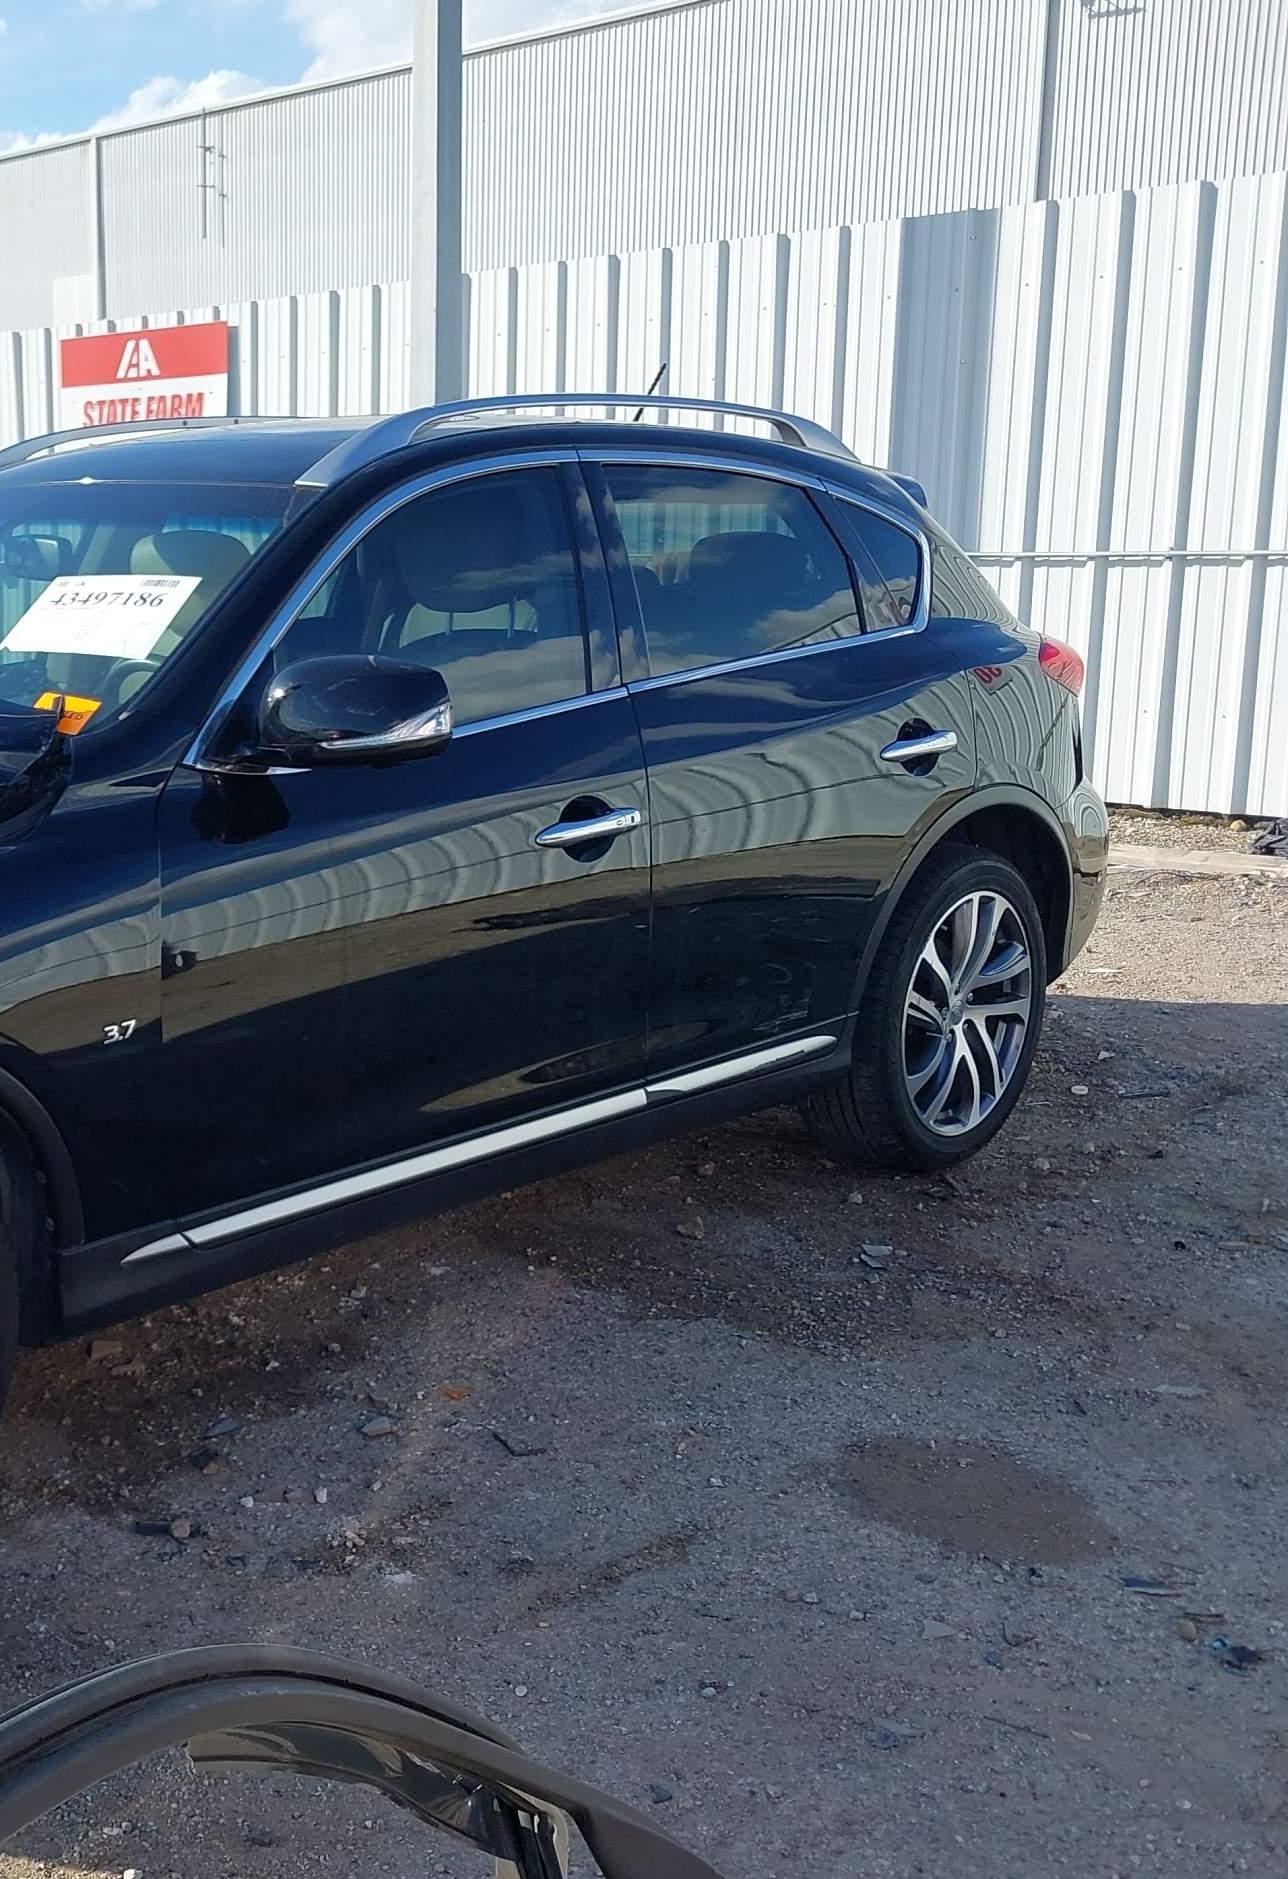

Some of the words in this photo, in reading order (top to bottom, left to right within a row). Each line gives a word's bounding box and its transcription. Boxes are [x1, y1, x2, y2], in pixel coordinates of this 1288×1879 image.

[83, 397, 141, 426] STATE
[146, 392, 205, 419] FARM
[50, 591, 169, 607] 43497186
